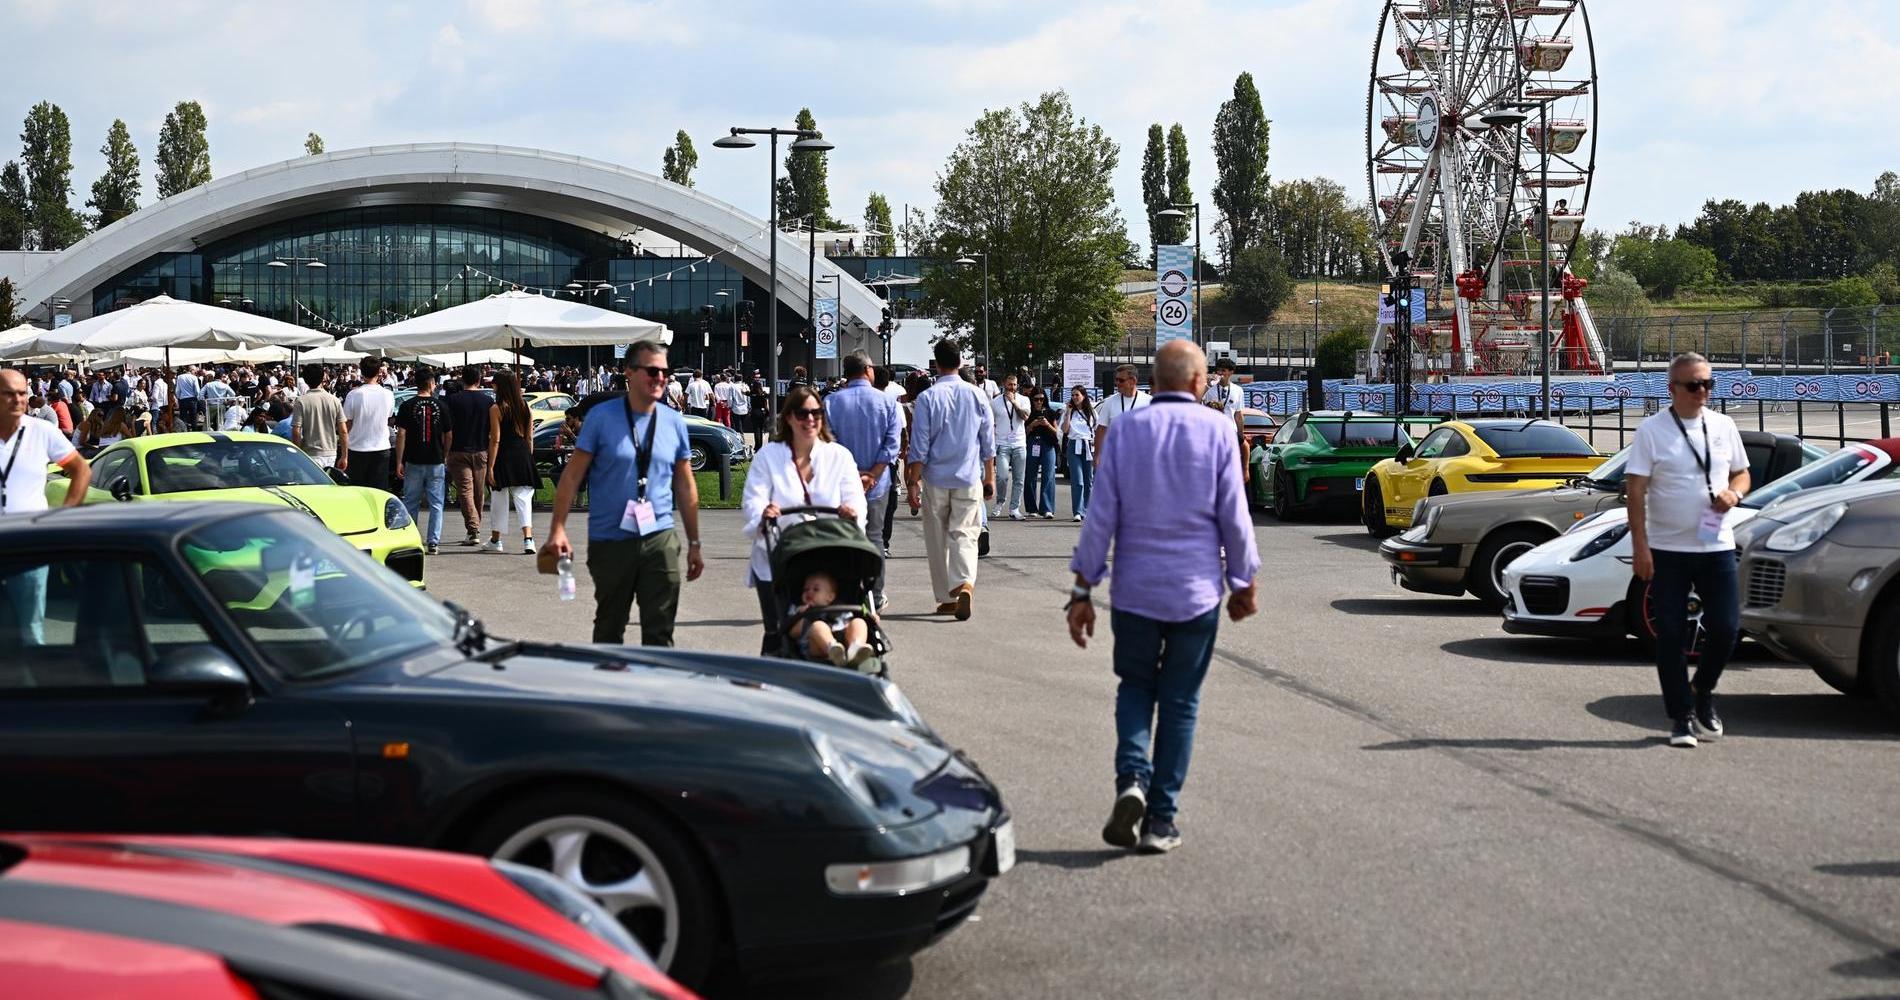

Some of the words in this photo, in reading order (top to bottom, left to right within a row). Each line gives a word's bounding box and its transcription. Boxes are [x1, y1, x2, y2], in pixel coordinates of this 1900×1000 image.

[1165, 306, 1182, 319] 26
[821, 332, 831, 341] 26
[1747, 385, 1756, 393] 26
[1871, 384, 1879, 392] 26
[1374, 393, 1382, 402] 26
[1488, 391, 1498, 400] 26
[1619, 389, 1628, 397] 26
